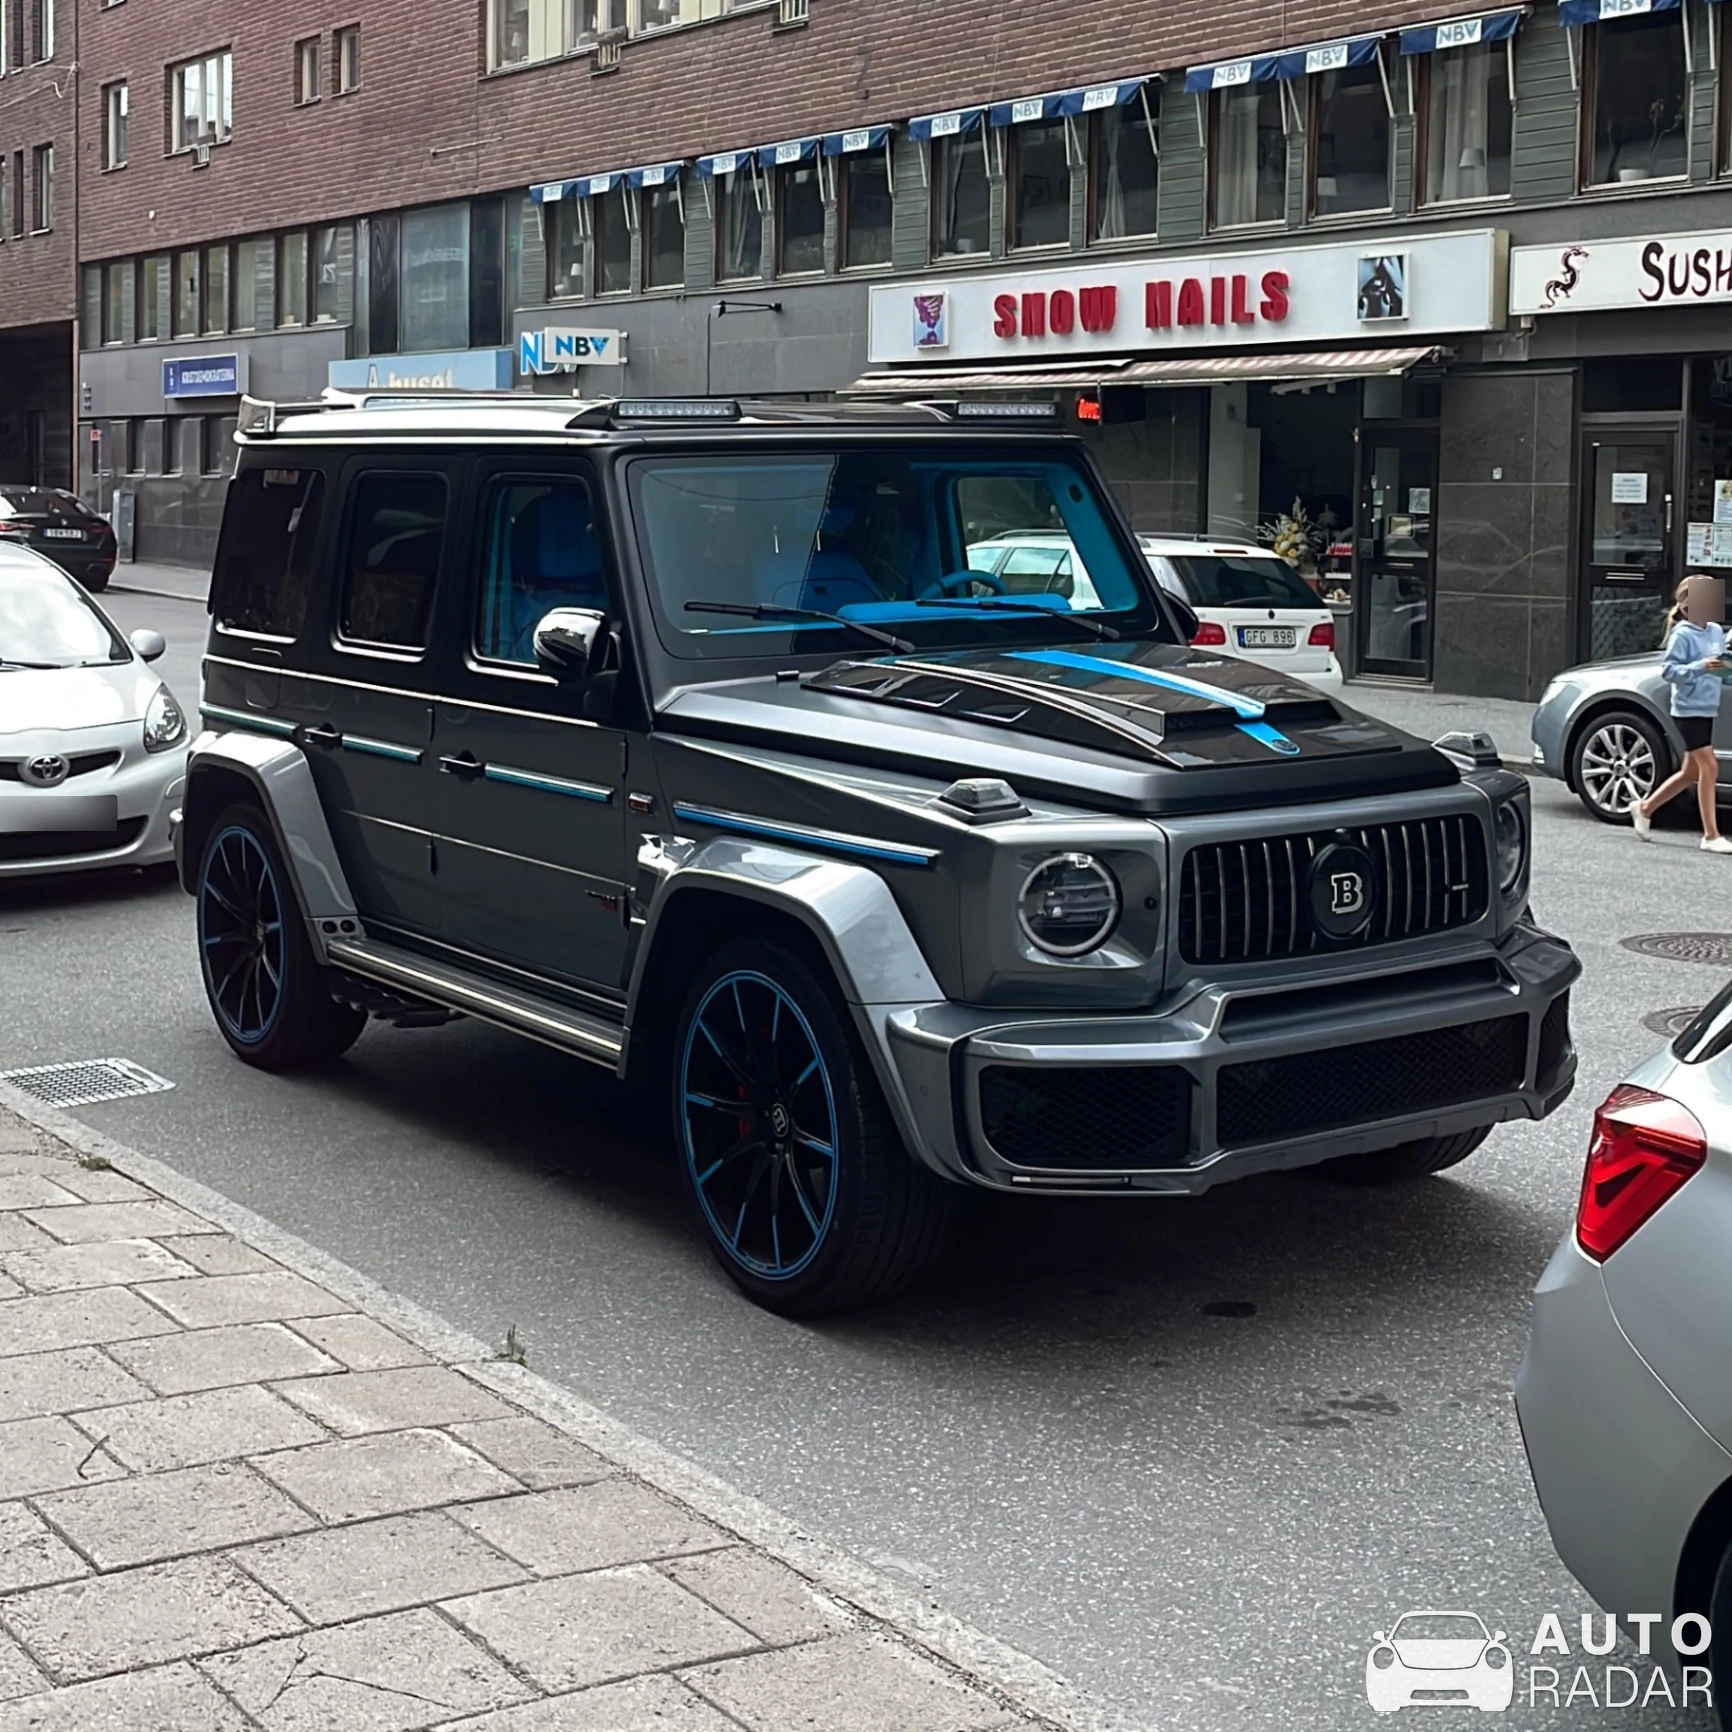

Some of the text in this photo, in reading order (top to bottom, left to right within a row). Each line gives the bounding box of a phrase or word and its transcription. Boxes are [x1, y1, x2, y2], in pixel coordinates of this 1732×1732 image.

[1438, 22, 1479, 44] NBV
[1308, 49, 1345, 68] NBV
[1214, 66, 1248, 84] NBV
[1085, 89, 1116, 107] NBV
[1013, 101, 1042, 119] NBV
[932, 117, 958, 134] NBV
[843, 133, 868, 150] NBV
[778, 146, 800, 161] NBV
[714, 157, 734, 172] NBV
[993, 271, 1290, 339] SNOW NAILS
[555, 335, 610, 358] NBV
[1246, 630, 1293, 643] GFG 896
[1331, 872, 1364, 914] B
